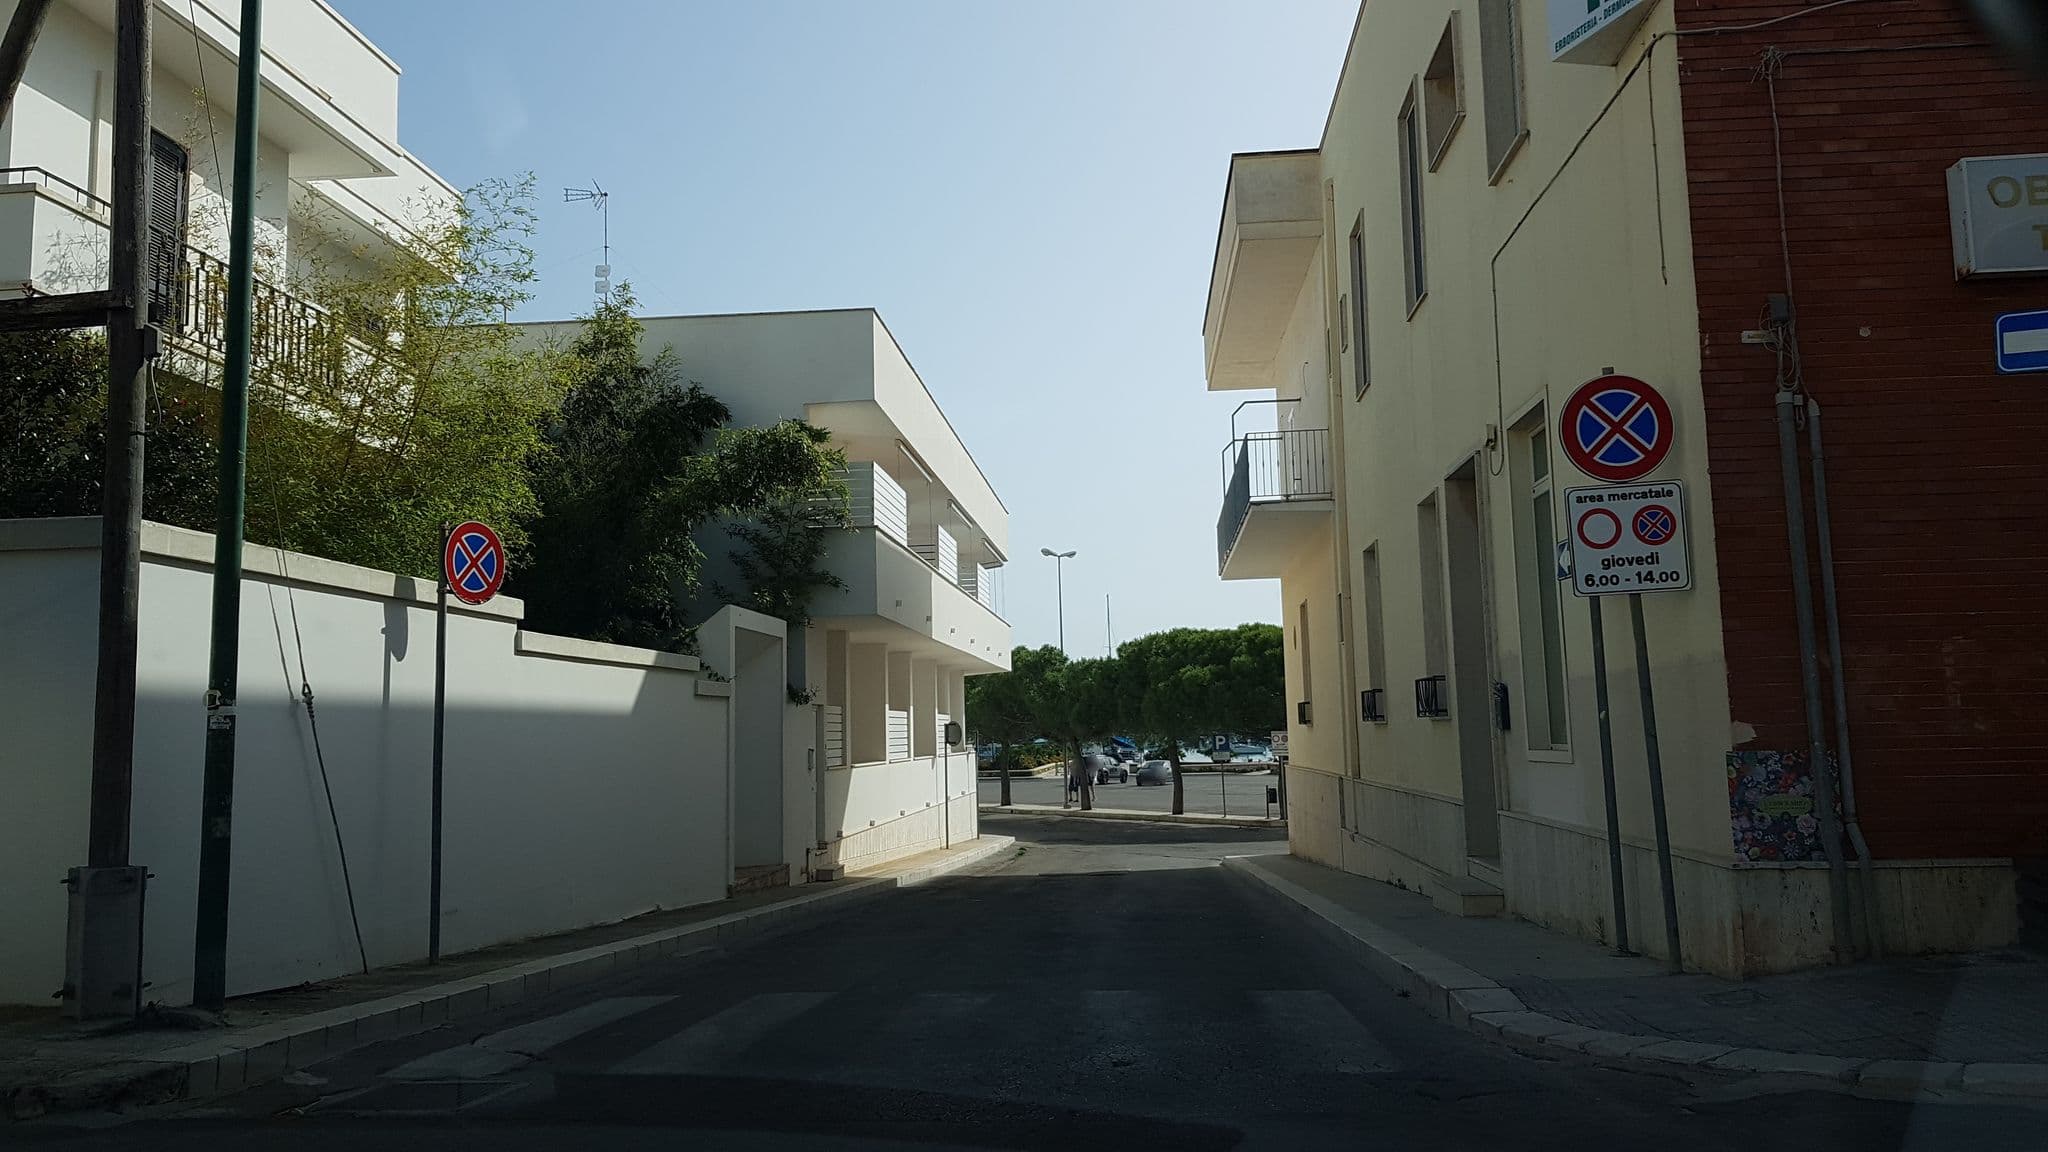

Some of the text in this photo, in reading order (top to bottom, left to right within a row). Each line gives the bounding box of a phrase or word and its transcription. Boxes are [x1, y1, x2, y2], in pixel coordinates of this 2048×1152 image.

[1555, 16, 1598, 52] ERBORISTERIA
[1575, 488, 1674, 504] area mercatale
[1215, 735, 1226, 750] P
